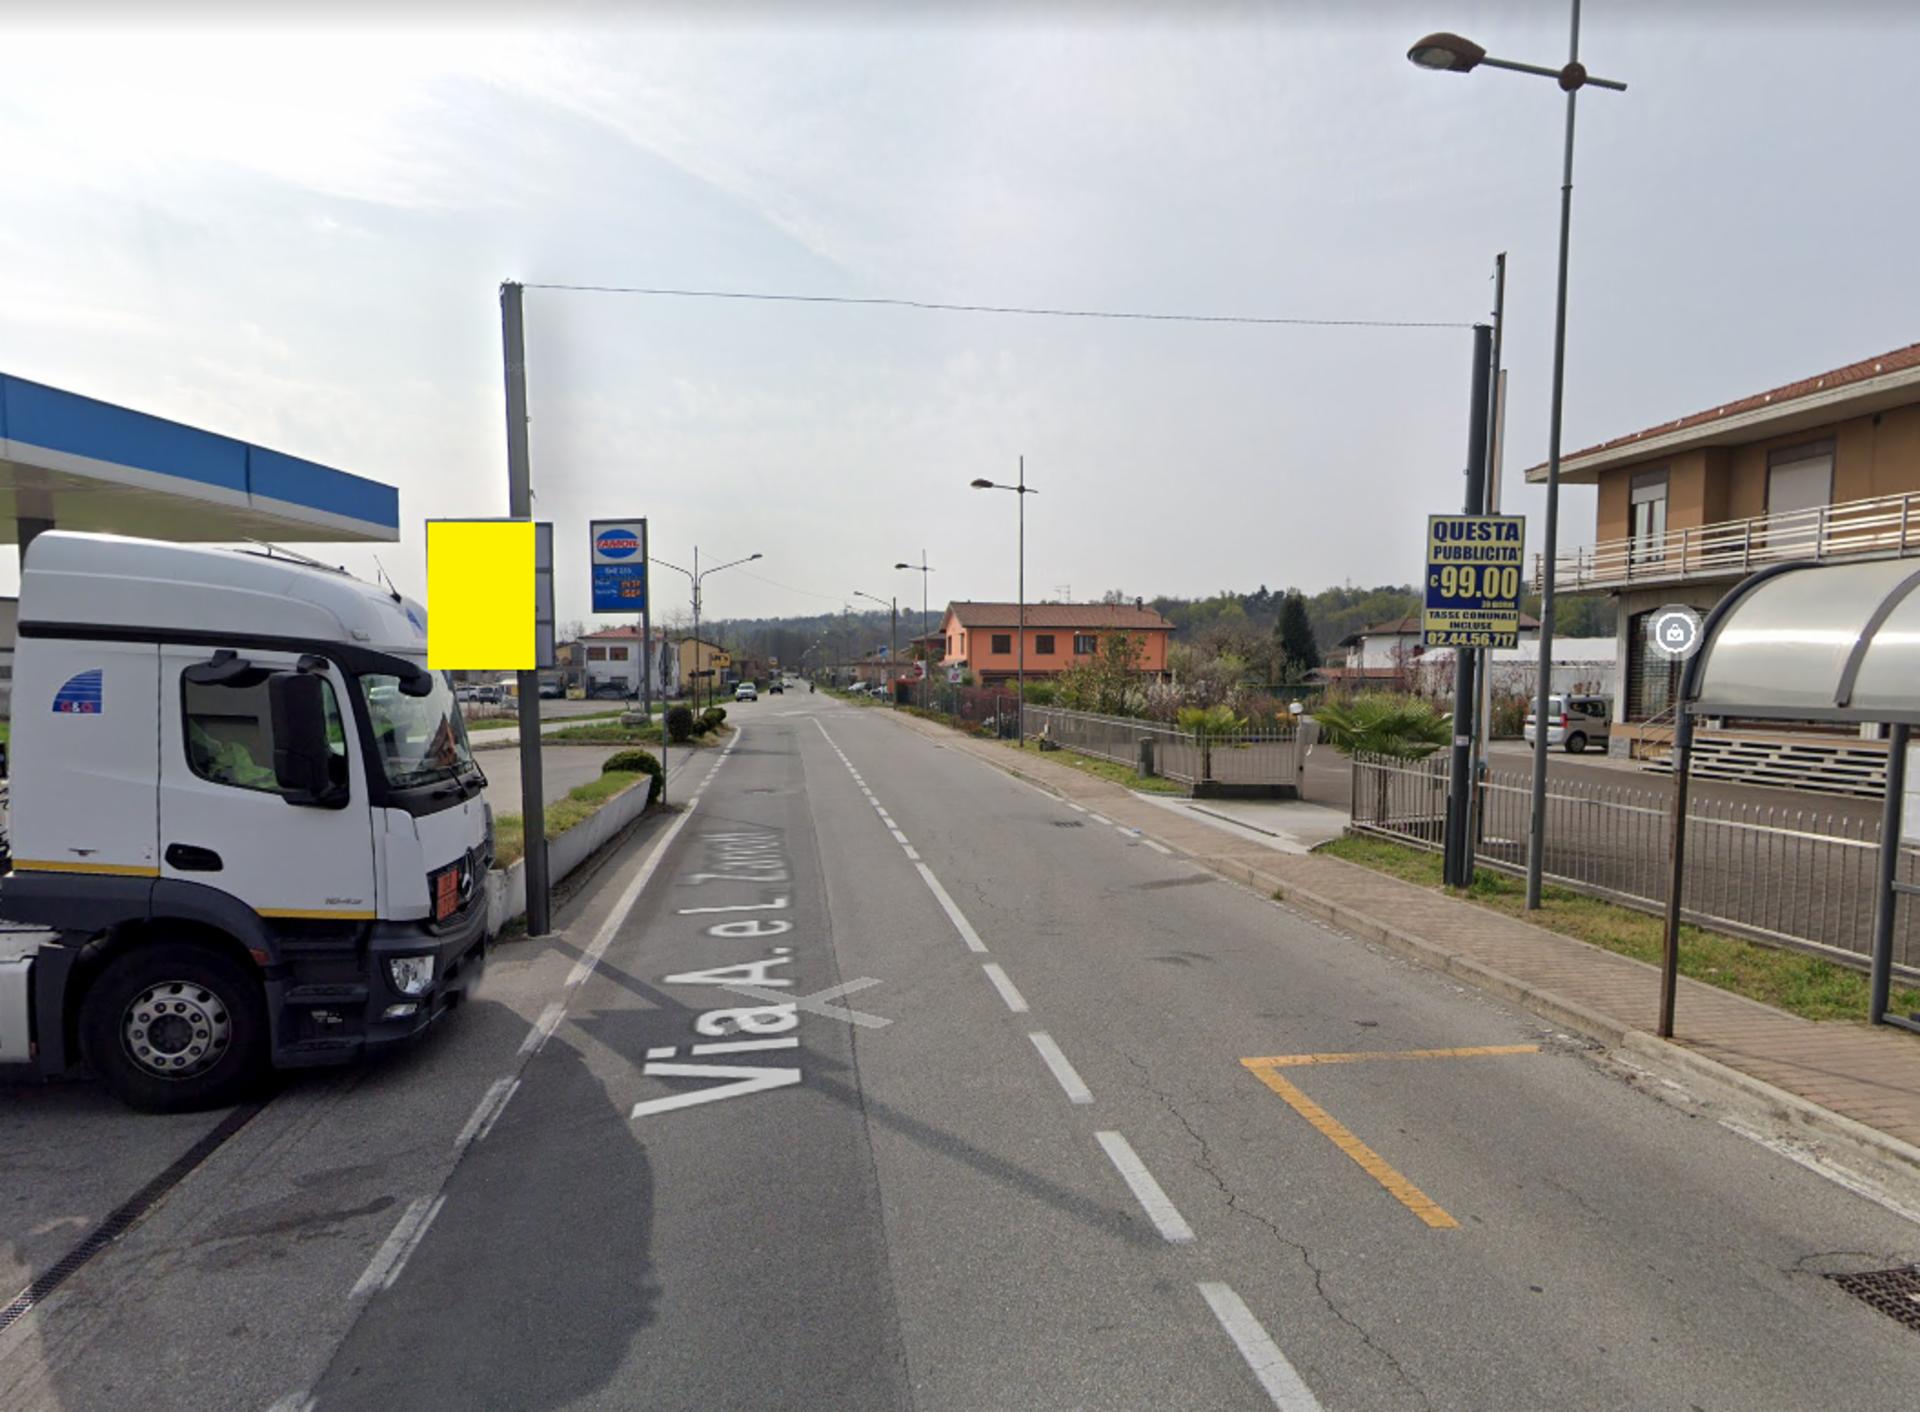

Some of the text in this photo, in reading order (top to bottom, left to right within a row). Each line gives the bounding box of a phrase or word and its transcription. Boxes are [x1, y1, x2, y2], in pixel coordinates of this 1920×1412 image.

[1433, 521, 1519, 542] QUESTA
[1429, 611, 1517, 620] TASSE COMUNALI
[1449, 621, 1492, 630] INCLUSE
[1427, 631, 1515, 647] 02.44.56.717
